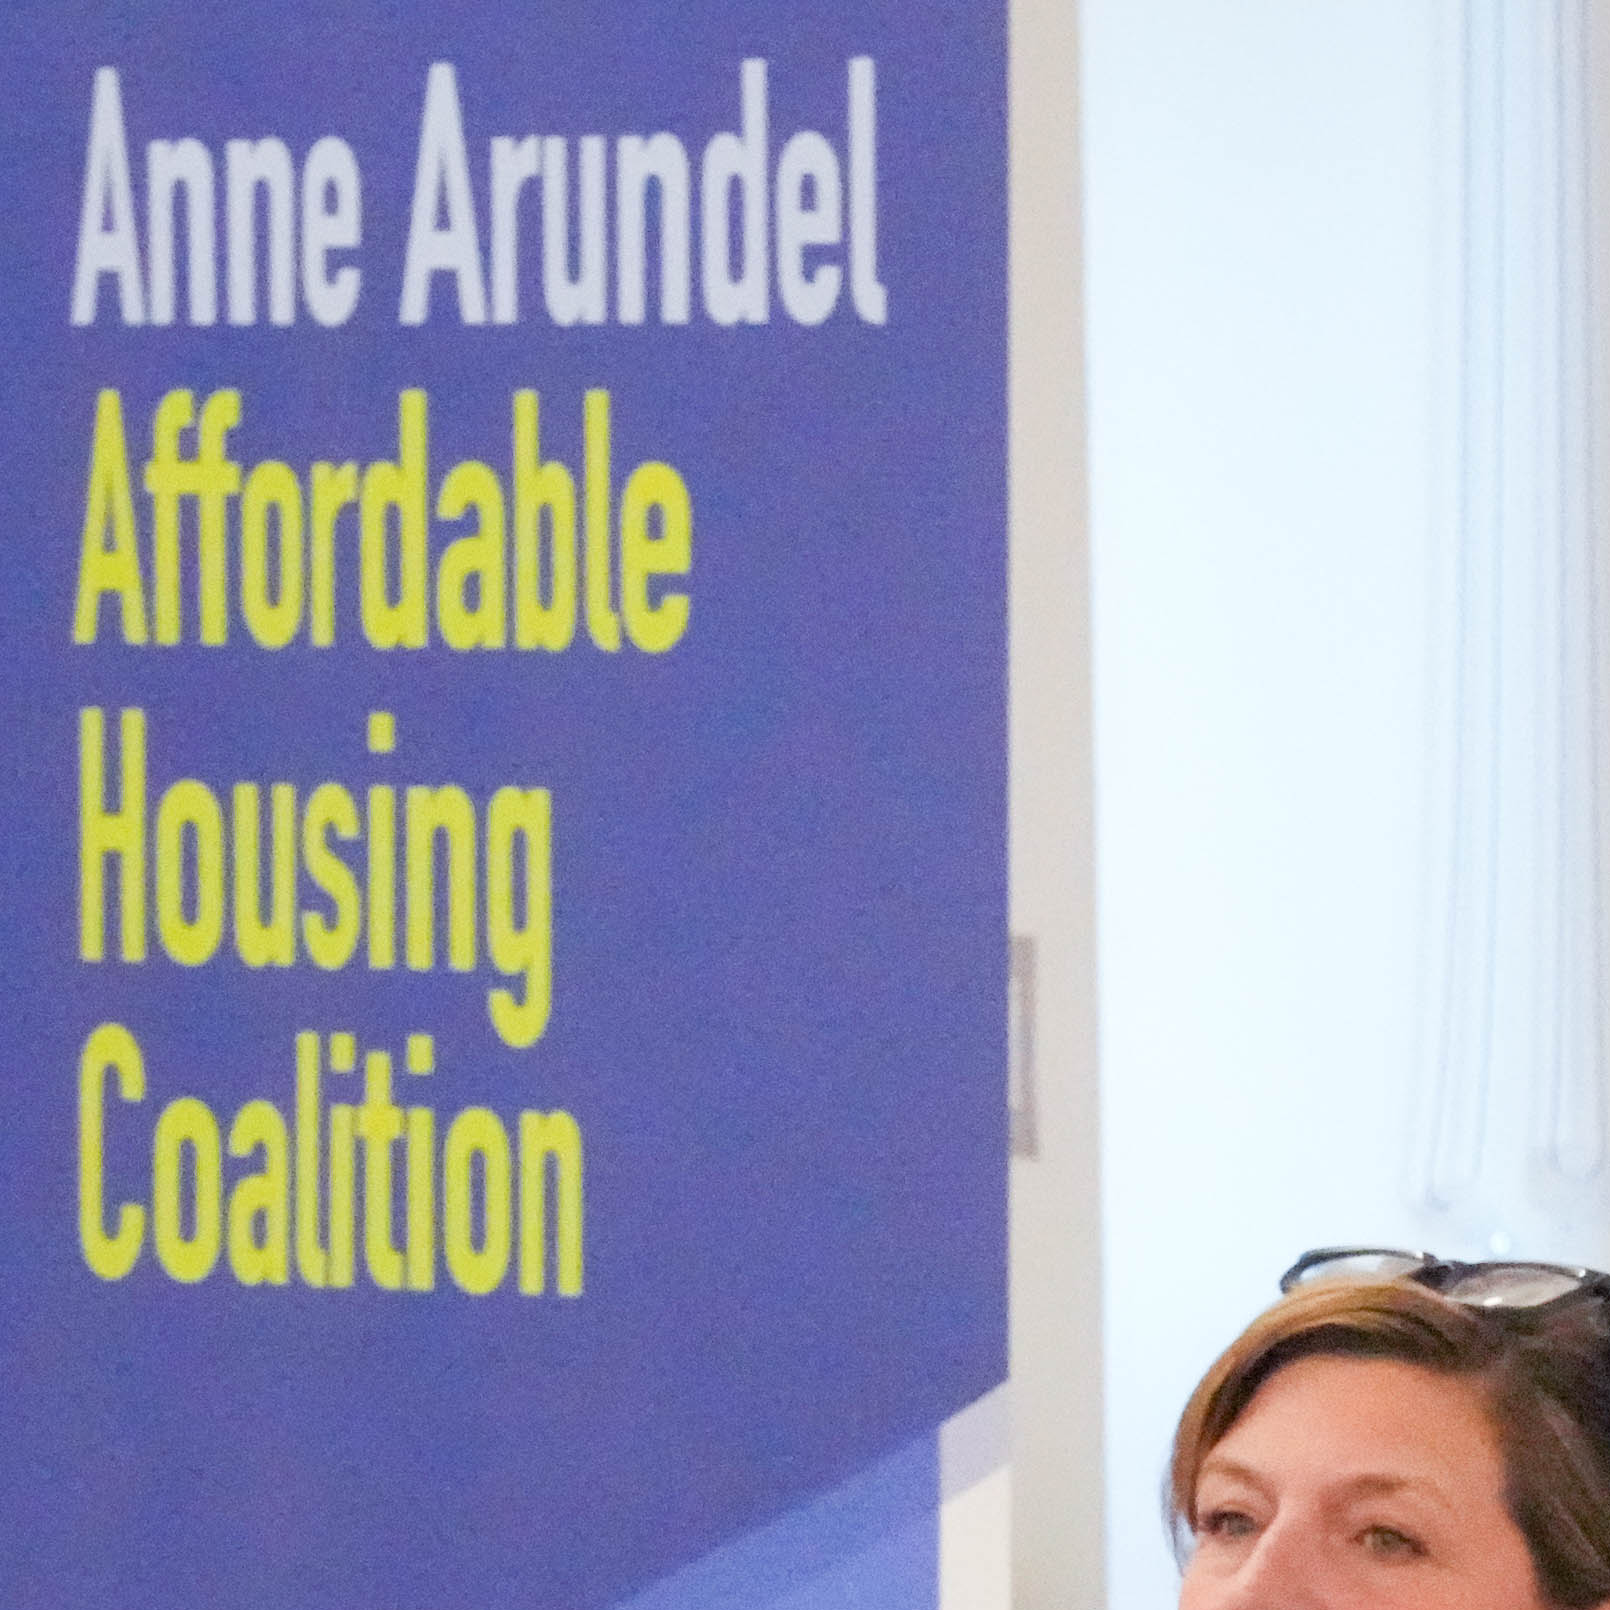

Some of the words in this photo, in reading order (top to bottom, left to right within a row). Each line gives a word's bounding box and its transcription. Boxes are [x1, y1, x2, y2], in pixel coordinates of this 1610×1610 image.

[70, 65, 363, 327] Anne
[399, 55, 887, 327] Arundel
[71, 387, 693, 654] Affordable
[78, 706, 553, 1049] Housing
[78, 1022, 584, 1297] Coalition
